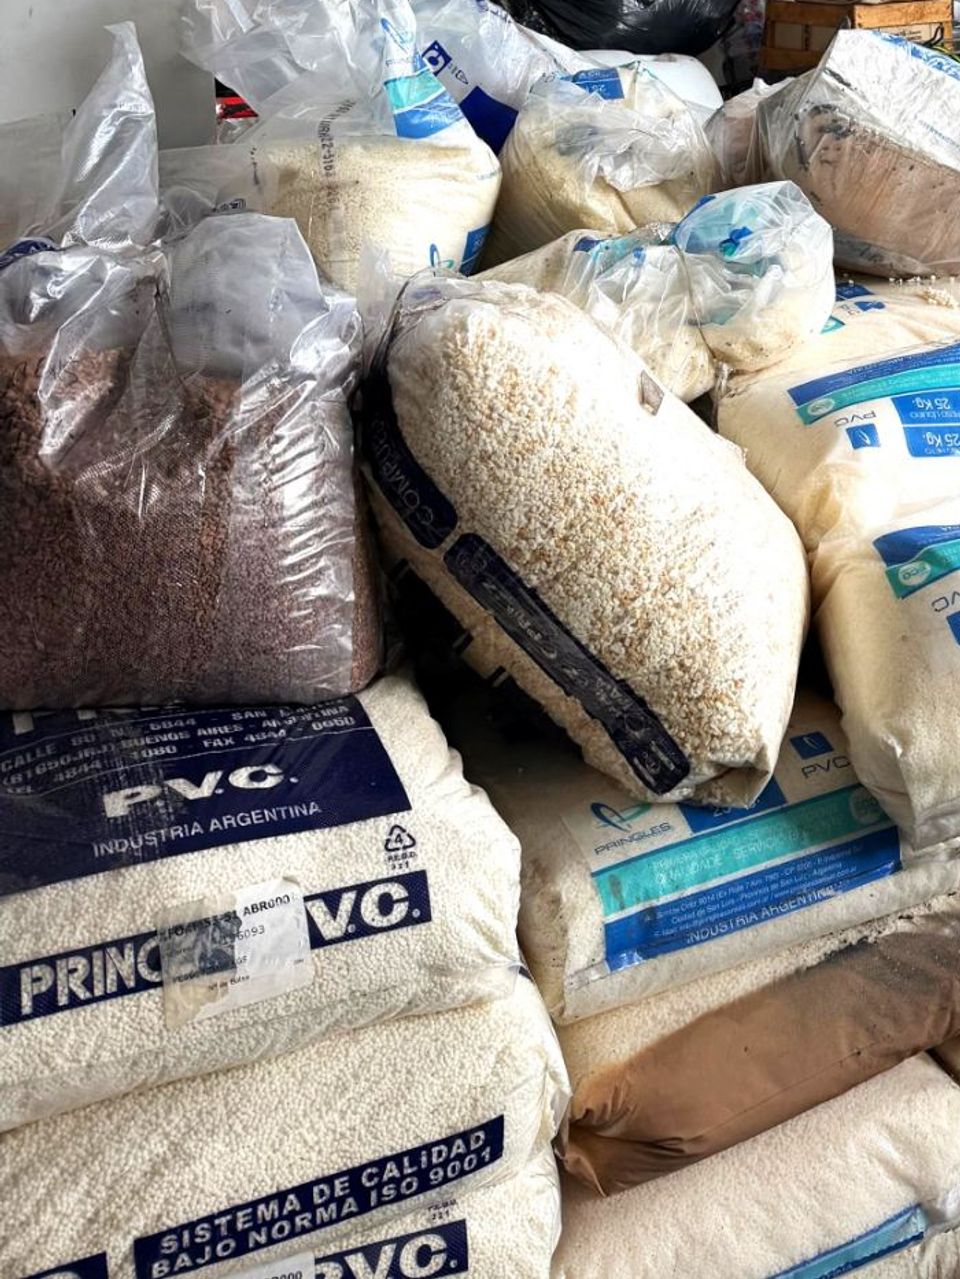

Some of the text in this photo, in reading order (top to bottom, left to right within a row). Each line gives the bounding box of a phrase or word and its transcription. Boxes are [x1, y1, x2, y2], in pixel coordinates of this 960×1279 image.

[910, 397, 951, 410] 25 Kg.
[833, 410, 877, 428] PVC
[922, 431, 944, 447] Kg.
[230, 709, 268, 721] SAN
[196, 724, 245, 737] AIRES
[203, 736, 236, 749] FAX
[102, 763, 299, 819] P.V.C.
[93, 801, 323, 859] INDUSTRIA ARGENTINA
[594, 821, 673, 856] PRINGLES
[686, 886, 838, 945] INDUSTRIA ARGENTINA
[151, 1148, 493, 1279] BAJO NORMA ISO 9001
[160, 1192, 302, 1256] SISTEMA
[312, 1176, 352, 1205] DE
